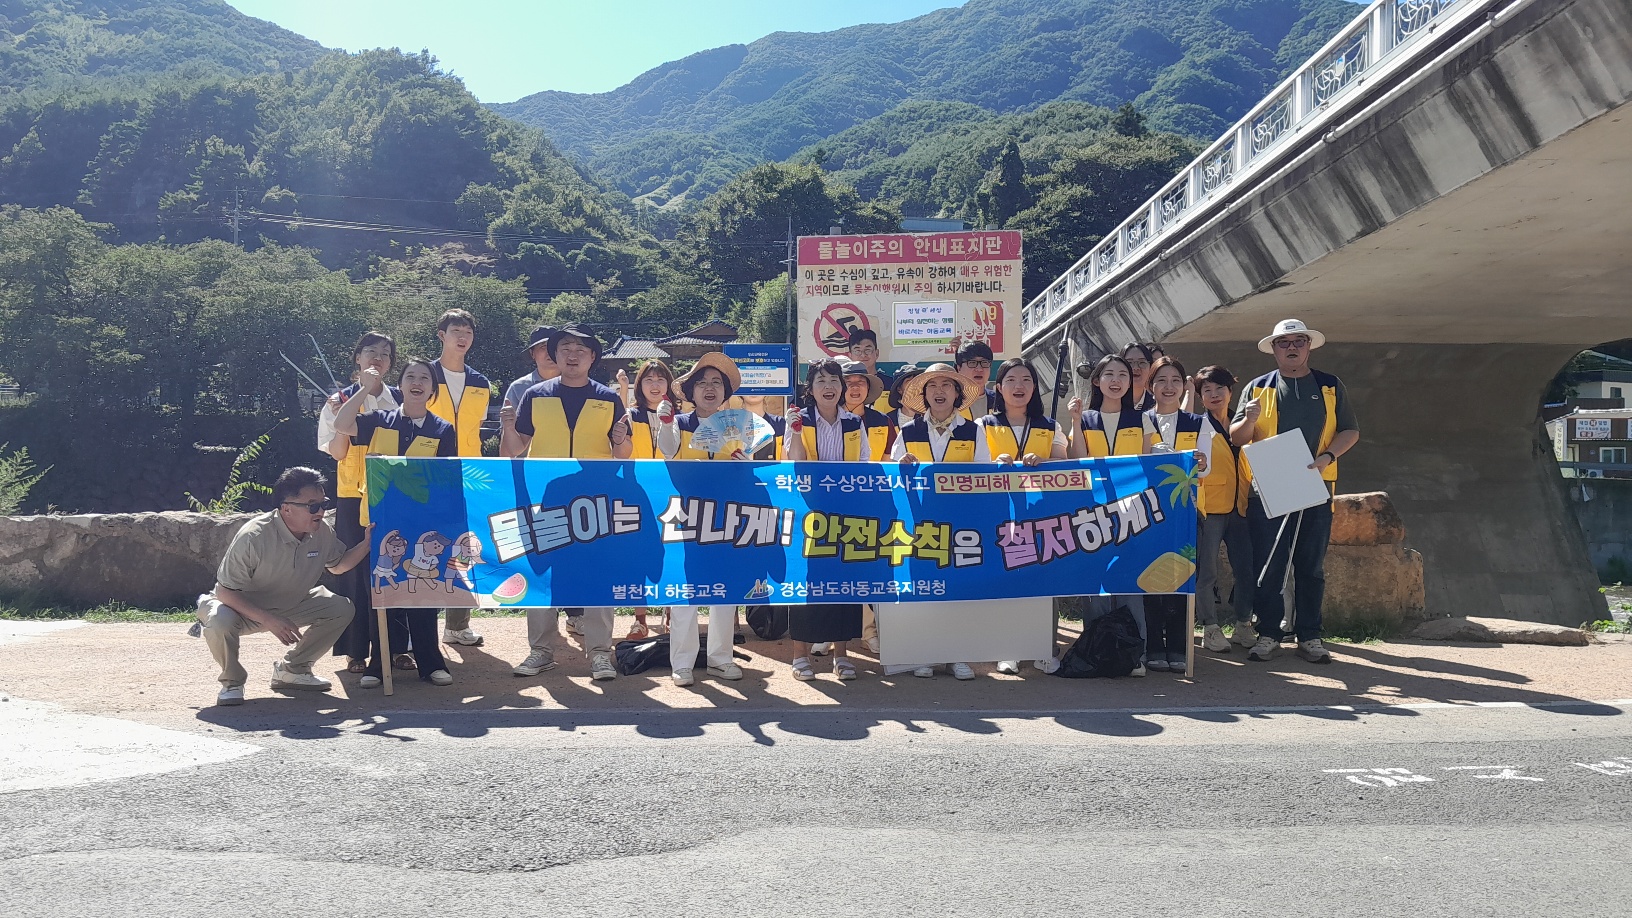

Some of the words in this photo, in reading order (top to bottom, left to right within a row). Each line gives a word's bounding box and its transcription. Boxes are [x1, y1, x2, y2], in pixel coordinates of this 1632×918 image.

[817, 239, 903, 260] 물놀이주의
[913, 236, 1003, 257] 안내표지판
[804, 269, 814, 282] 이
[817, 268, 836, 282] 곳은
[839, 268, 867, 281] 수심이
[871, 268, 892, 281] 깊고,
[896, 266, 924, 280] 유속이
[928, 265, 956, 279] 강하여
[960, 264, 980, 278] 매우
[983, 264, 1013, 277] 위험한
[805, 284, 851, 297] 지역이므로
[913, 282, 933, 294] 주의
[937, 280, 1005, 294] 하시기바랍니다.
[972, 305, 997, 321] 119
[774, 473, 813, 492] 학생
[819, 473, 931, 492] 수상안전사고
[936, 473, 1012, 492] 인명피해
[1018, 470, 1089, 490] ZERO화
[487, 494, 642, 564] 물놀이는
[658, 495, 794, 548] 신나게!
[802, 508, 984, 569] 안전수칙은
[996, 486, 1165, 571] 철저하게!
[612, 583, 660, 600] 별천지
[665, 583, 727, 600] 하동교육
[780, 579, 946, 598] 경상남도하동교육지원청
